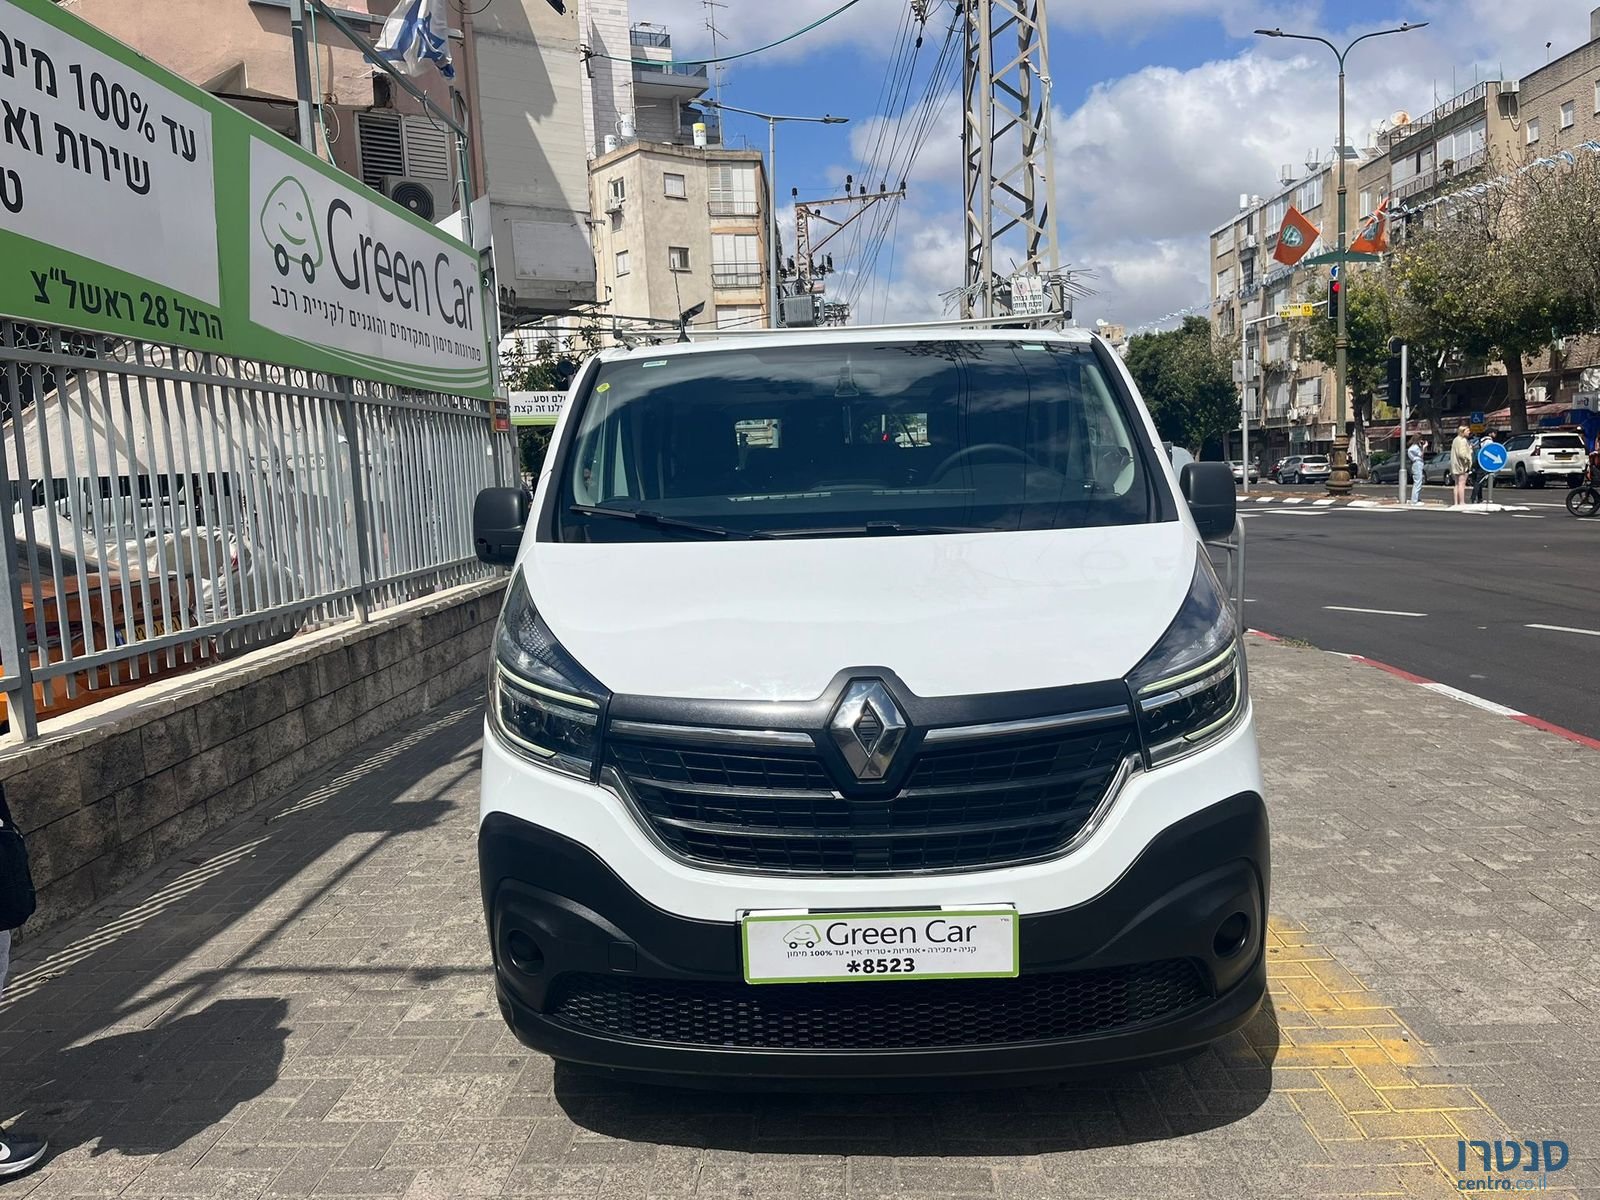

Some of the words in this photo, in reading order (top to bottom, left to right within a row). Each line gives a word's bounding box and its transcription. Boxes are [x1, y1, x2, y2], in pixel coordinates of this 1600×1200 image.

[68, 64, 156, 143] 100%
[160, 114, 196, 162] עד
[54, 122, 151, 195] שירות
[327, 198, 431, 316] Green
[434, 252, 474, 331] Car
[140, 291, 169, 329] 28
[271, 284, 298, 311] רכב
[302, 294, 344, 327] לקניית
[173, 298, 224, 341] הרצל
[349, 309, 387, 336] והוגנים
[390, 322, 431, 348] מתקדמים
[432, 335, 453, 354] מימון
[454, 341, 481, 362] פתרונות
[514, 404, 533, 414] קצת
[535, 404, 546, 412] זה
[826, 922, 917, 946] Green
[925, 919, 977, 943] Car
[787, 950, 808, 959] מימון
[851, 948, 863, 957] אין
[892, 947, 921, 955] אחריות
[927, 946, 952, 954] מכירה
[958, 946, 977, 954] קניה
